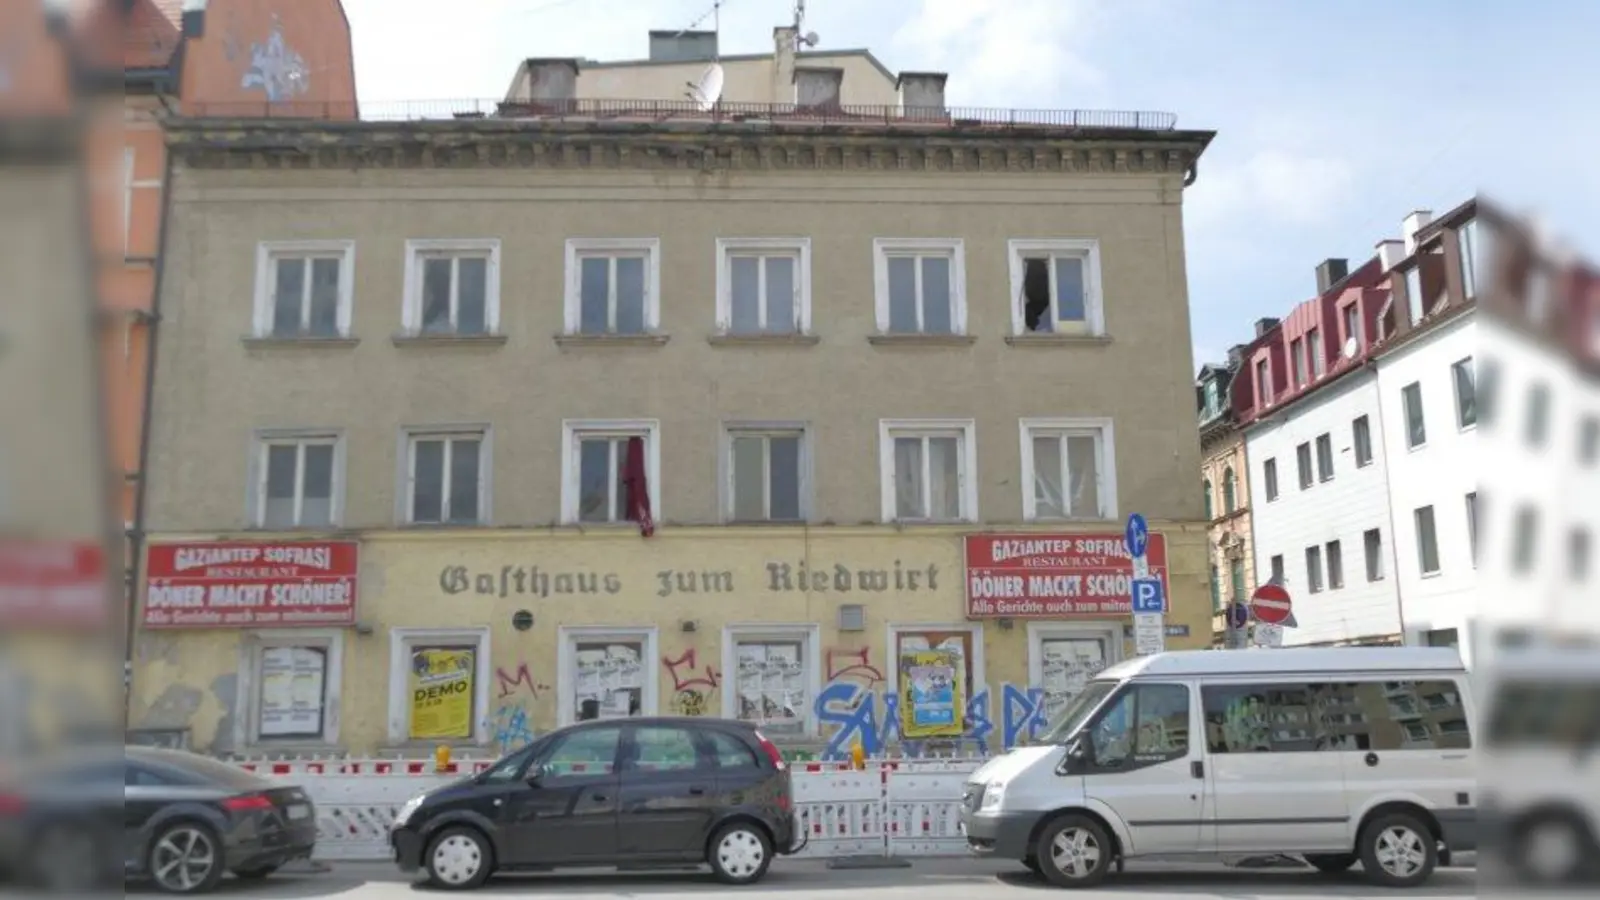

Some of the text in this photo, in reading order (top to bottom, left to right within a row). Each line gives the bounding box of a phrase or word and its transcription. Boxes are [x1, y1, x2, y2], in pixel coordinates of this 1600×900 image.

[206, 567, 298, 577] RESTAURANT
[1023, 556, 1107, 567] RESTAURANT
[656, 569, 734, 597] zum
[766, 561, 939, 593] Riedwirt
[972, 572, 1024, 598] DÖNER
[1029, 575, 1081, 597] MACHT
[148, 579, 205, 607] DÖNER
[208, 584, 267, 606] MACHT
[1139, 583, 1156, 608] P
[972, 600, 994, 614] Alle
[997, 600, 1043, 614] Gerichte
[1046, 599, 1073, 612] auch
[414, 680, 467, 702] DEMO
